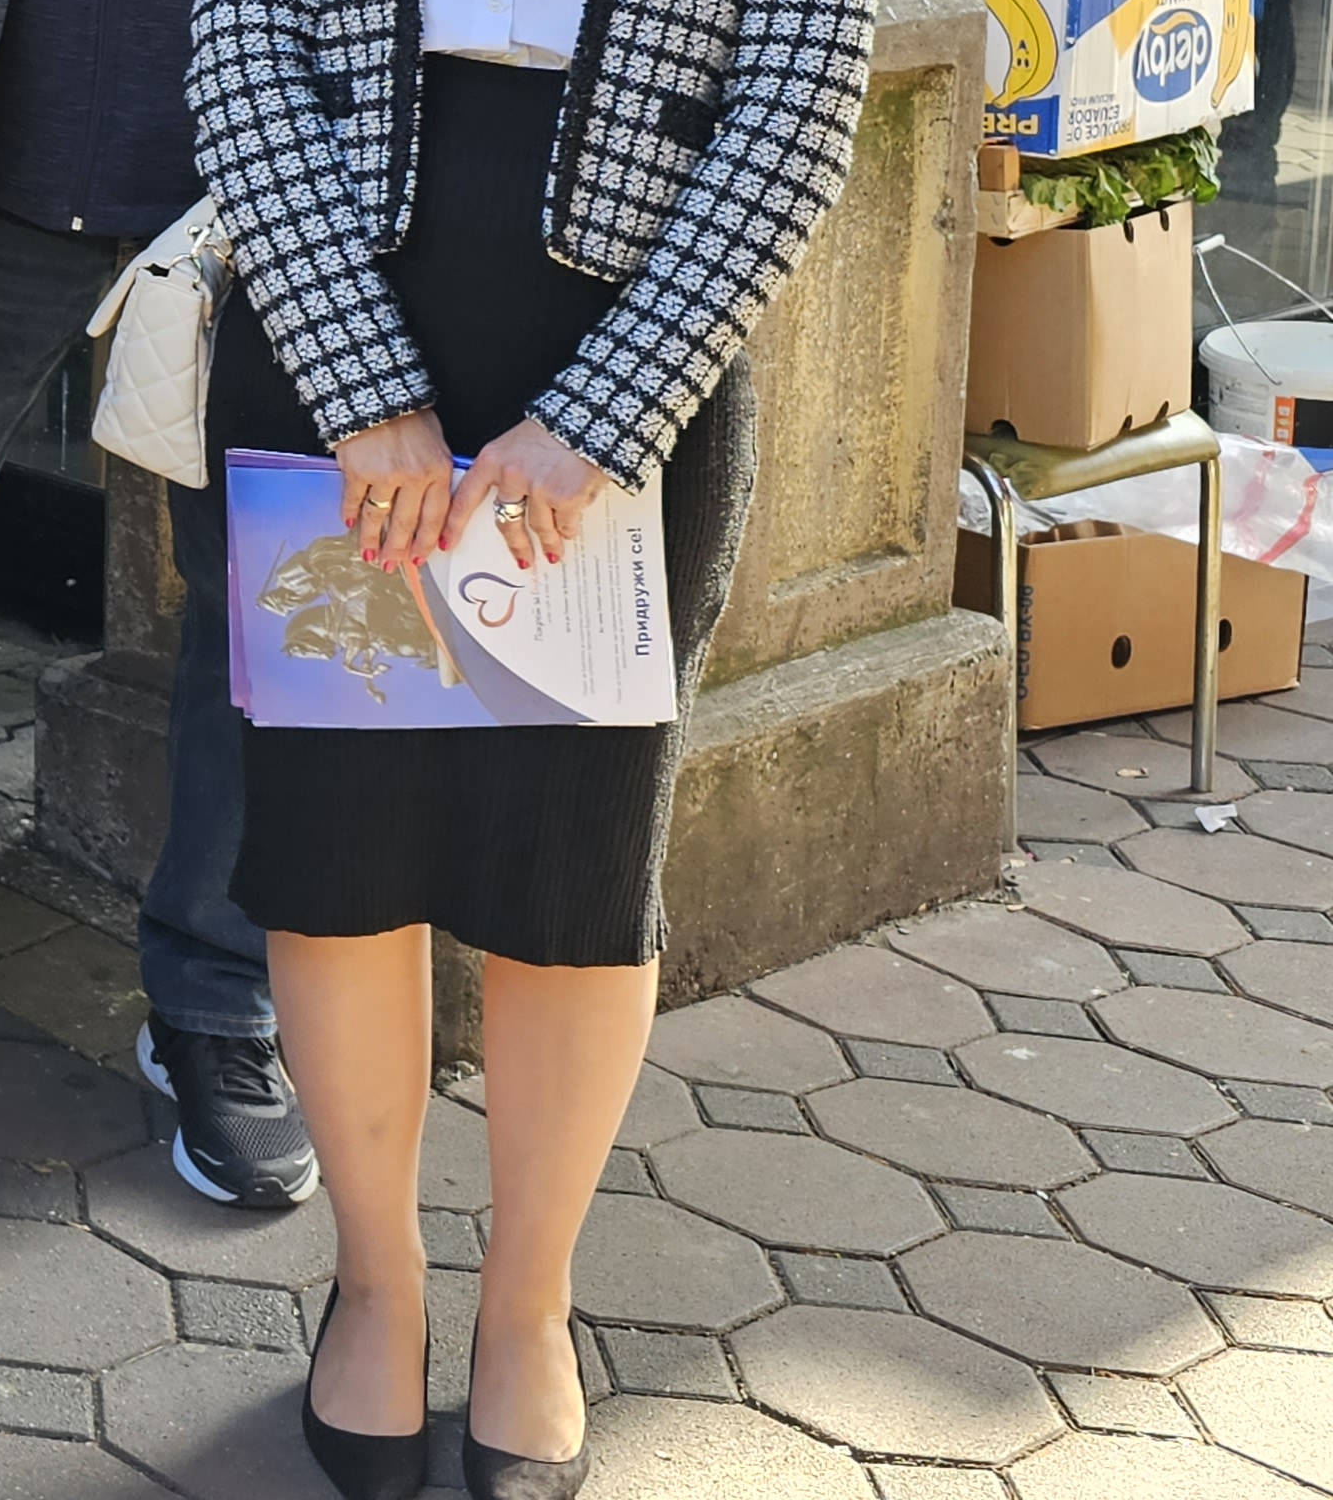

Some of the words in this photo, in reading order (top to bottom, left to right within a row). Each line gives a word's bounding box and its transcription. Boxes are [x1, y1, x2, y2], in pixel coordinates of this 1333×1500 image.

[1136, 24, 1208, 92] derby
[626, 527, 643, 555] се!
[633, 560, 652, 656] Придружи
